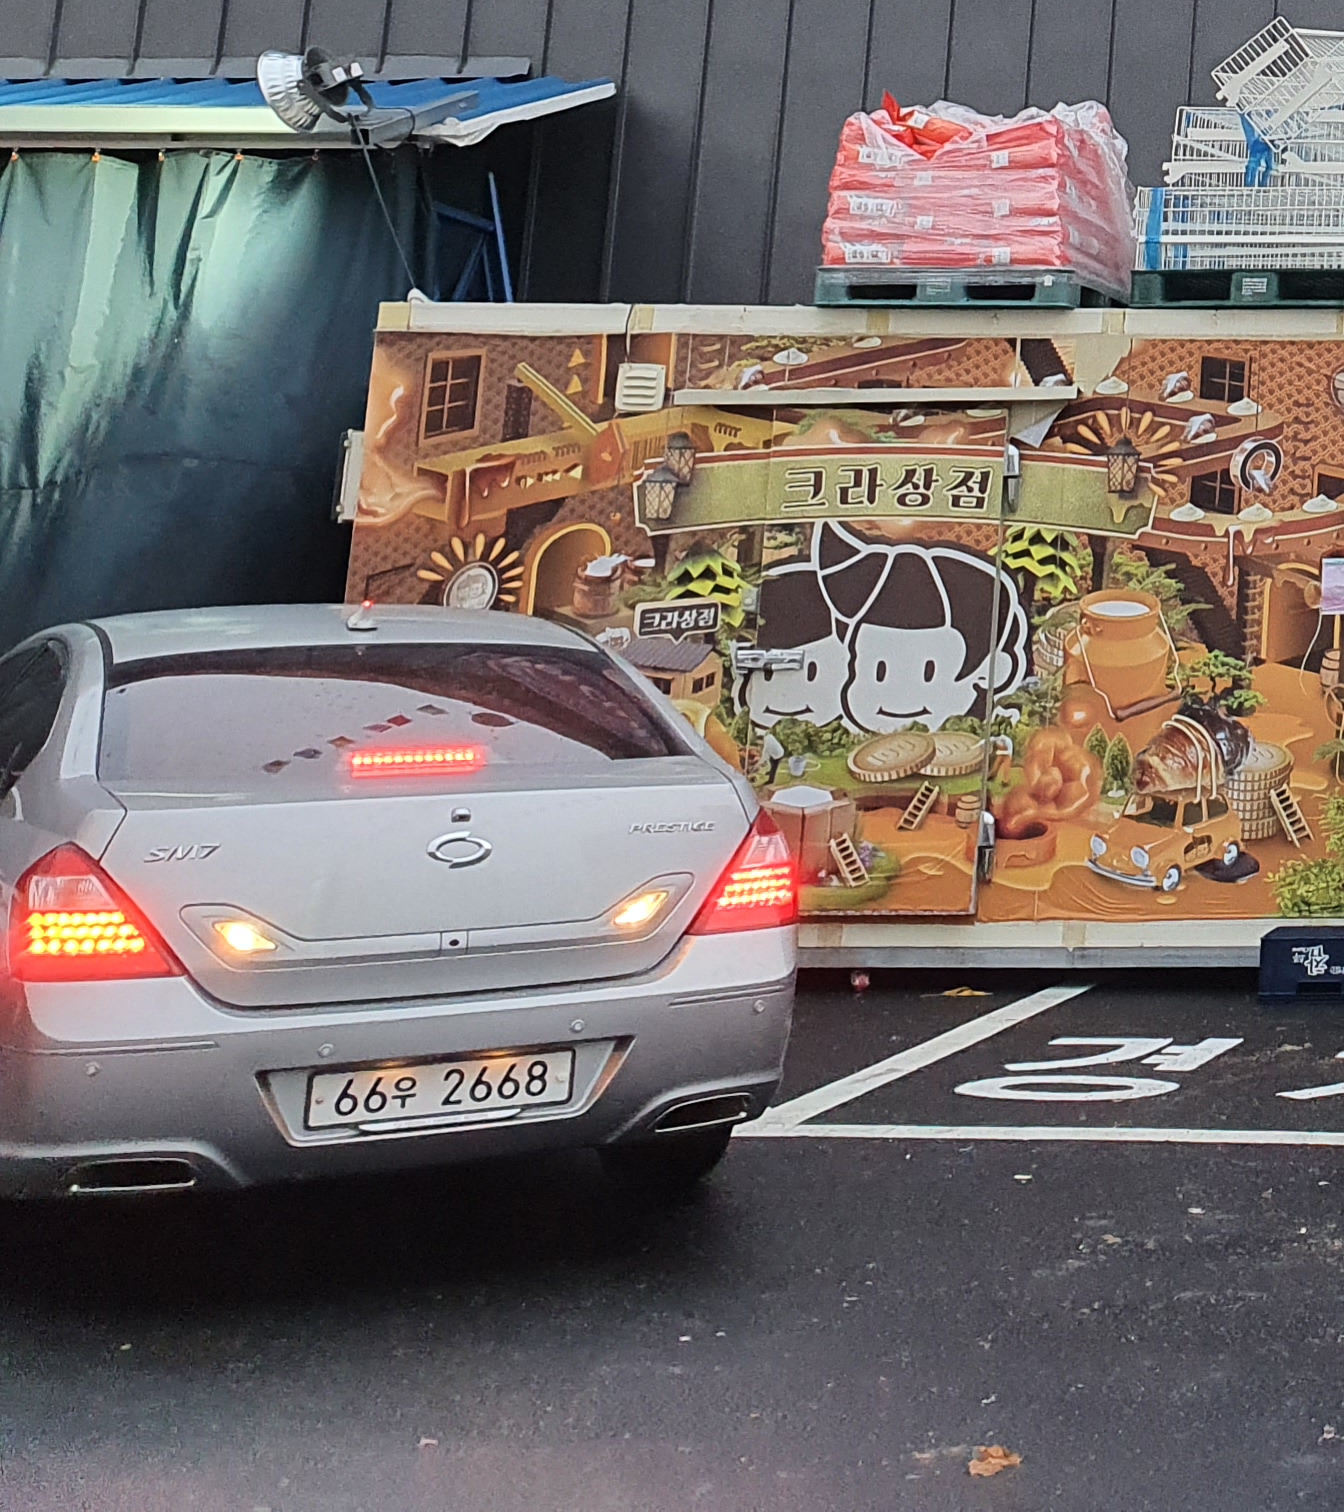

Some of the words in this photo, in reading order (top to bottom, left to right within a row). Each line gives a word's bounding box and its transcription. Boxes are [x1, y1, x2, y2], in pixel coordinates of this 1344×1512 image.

[783, 464, 992, 511] 크라상점
[641, 607, 716, 633] 크라상점
[143, 842, 222, 864] SM7
[334, 1076, 418, 1117] 66우
[441, 1060, 548, 1106] 2668
